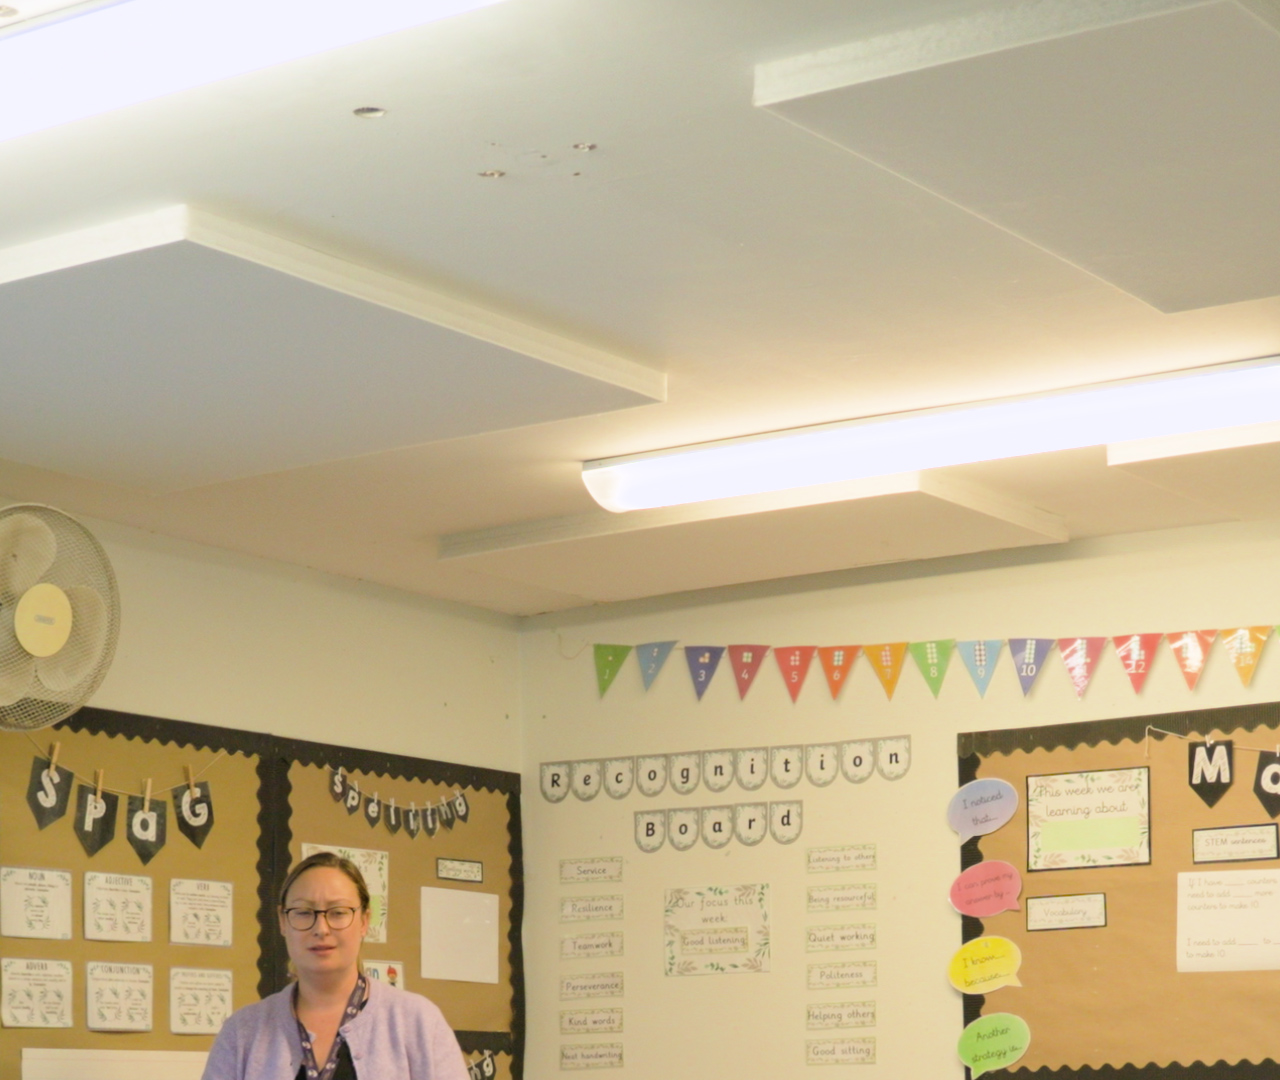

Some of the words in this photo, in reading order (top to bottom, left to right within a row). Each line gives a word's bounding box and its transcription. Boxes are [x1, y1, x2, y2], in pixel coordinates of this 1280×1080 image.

[1020, 664, 1036, 677] 10
[550, 749, 900, 788] Recognition
[1065, 783, 1093, 796] week
[1097, 785, 1114, 795] we
[971, 790, 1004, 807] noticed
[1045, 804, 1092, 818] learning
[1095, 801, 1127, 813] about
[644, 810, 792, 838] Board
[1205, 838, 1228, 847] STEM
[576, 866, 607, 876] Service
[105, 875, 133, 887] ADJECTIVE
[571, 903, 613, 914] Resilience
[700, 896, 730, 912] focus
[734, 895, 755, 906] this
[1043, 907, 1088, 919] Vocabulary
[682, 936, 705, 947] Good
[708, 934, 747, 948] listening
[808, 931, 836, 944] Quiet
[839, 930, 876, 943] working
[571, 939, 614, 950] Teamwork
[820, 970, 864, 981] Politeness
[565, 981, 620, 993] Perseverance
[568, 1016, 588, 1027] Kind
[592, 1015, 616, 1026] words
[807, 1010, 843, 1023] Helping
[976, 1027, 1011, 1042] Another
[812, 1045, 836, 1058] Good
[841, 1044, 872, 1058] sitting
